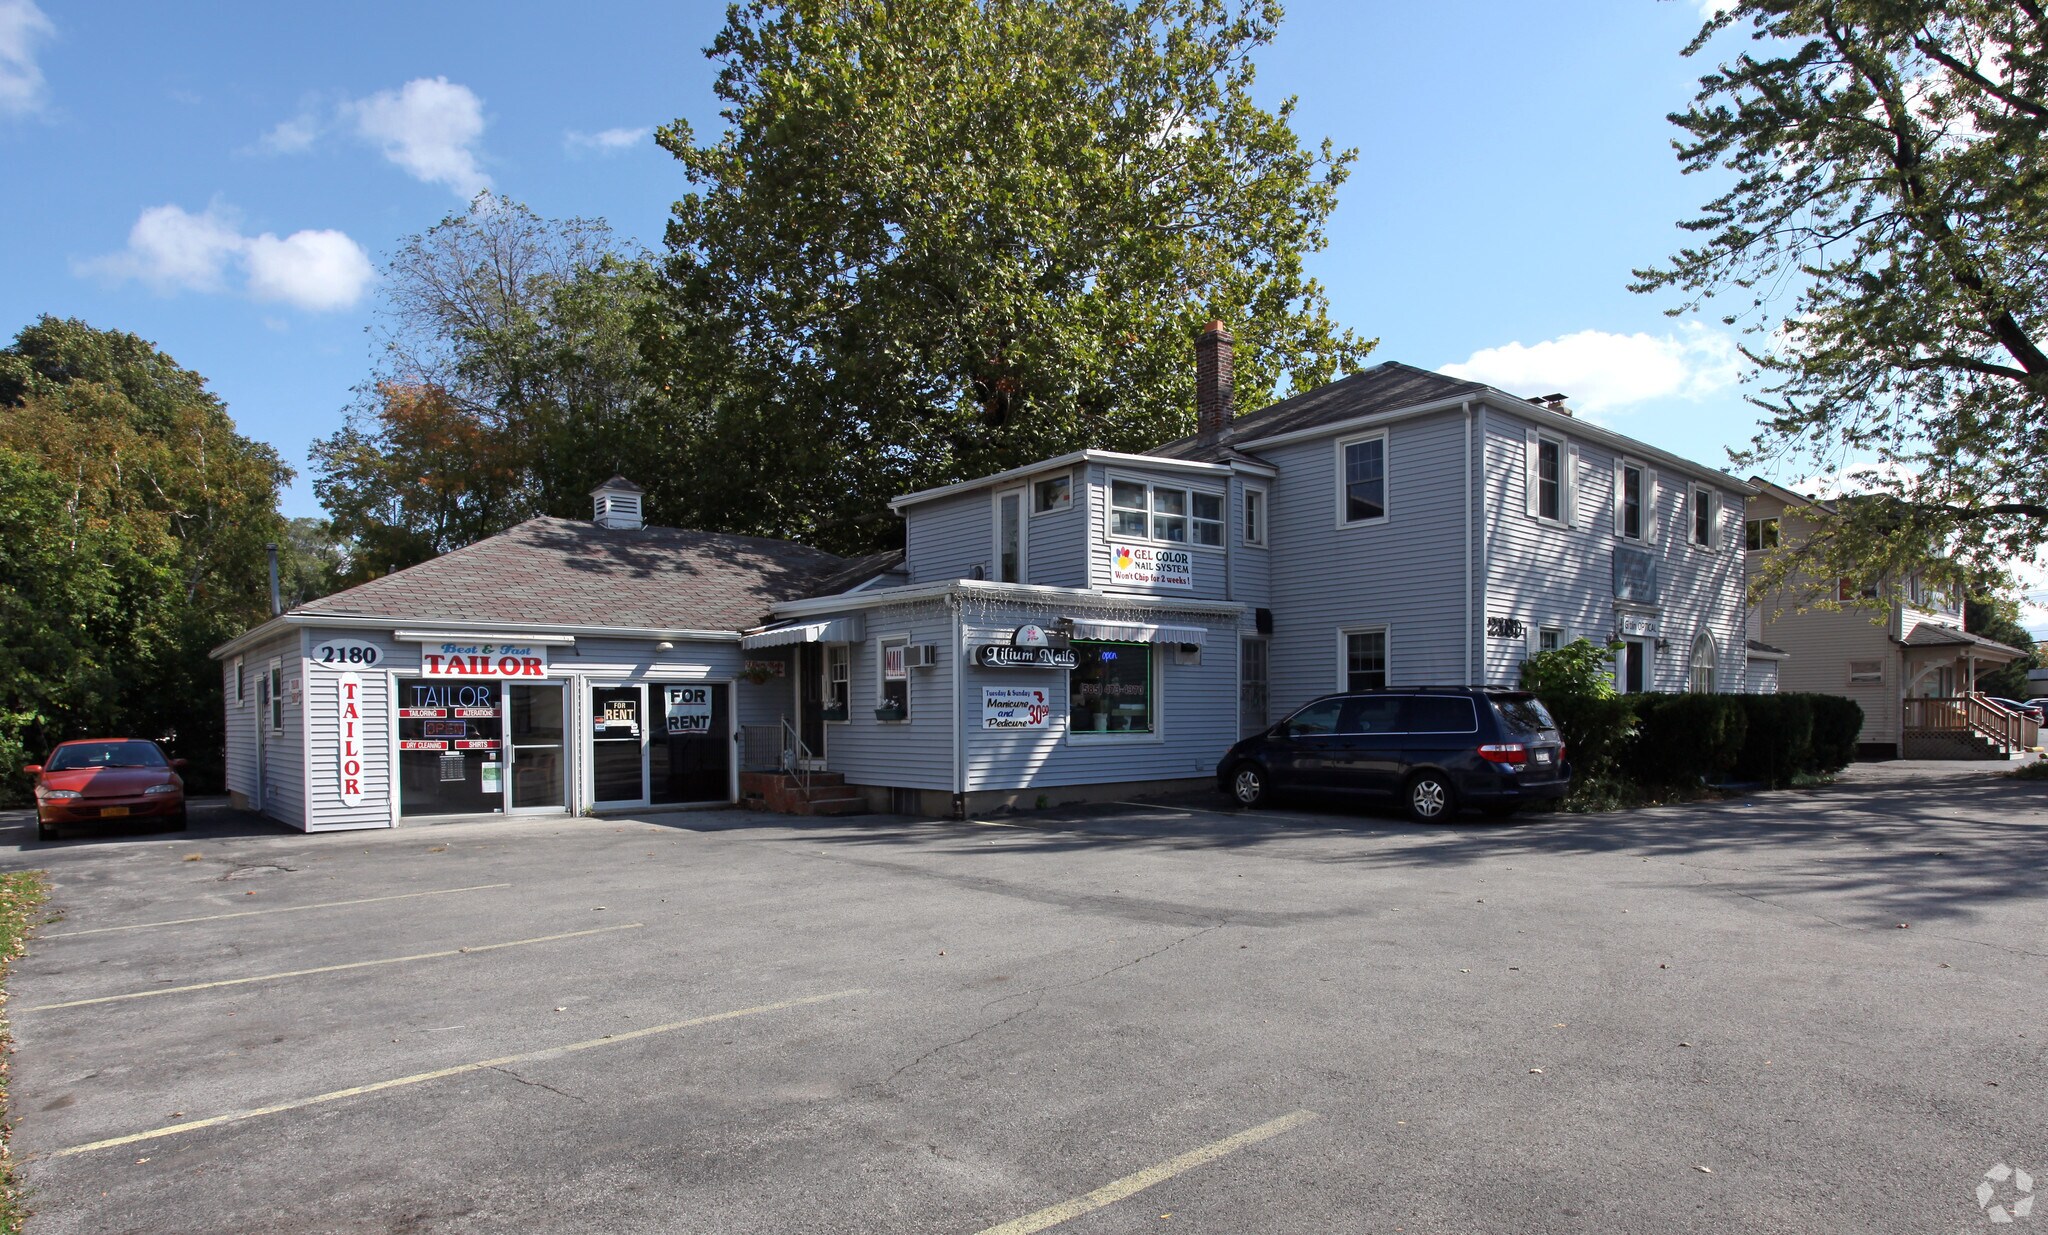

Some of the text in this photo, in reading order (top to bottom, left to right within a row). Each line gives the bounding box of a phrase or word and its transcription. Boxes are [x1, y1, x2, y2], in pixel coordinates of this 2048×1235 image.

[1134, 549, 1188, 564] GEL COLOR
[1134, 561, 1189, 574] NAIL SYSTEM
[1115, 571, 1133, 580] Won't
[1134, 572, 1149, 583] Chip
[1150, 574, 1160, 583] for
[1161, 575, 1166, 583] 2
[321, 646, 377, 664] 2180
[441, 643, 532, 655] Best & Fast
[986, 646, 1076, 667] Lilium Nails
[424, 655, 544, 675] TAILOR
[412, 686, 490, 707] TAILOR
[670, 689, 705, 702] FOR
[986, 698, 1029, 708] Manicure
[606, 709, 634, 720] RENT
[997, 709, 1014, 718] and
[426, 723, 463, 734] OPEN
[667, 715, 709, 730] RENT
[986, 717, 1028, 728] Pedicure
[343, 683, 361, 795] TAILOR
[468, 741, 488, 749] SHIRTS
